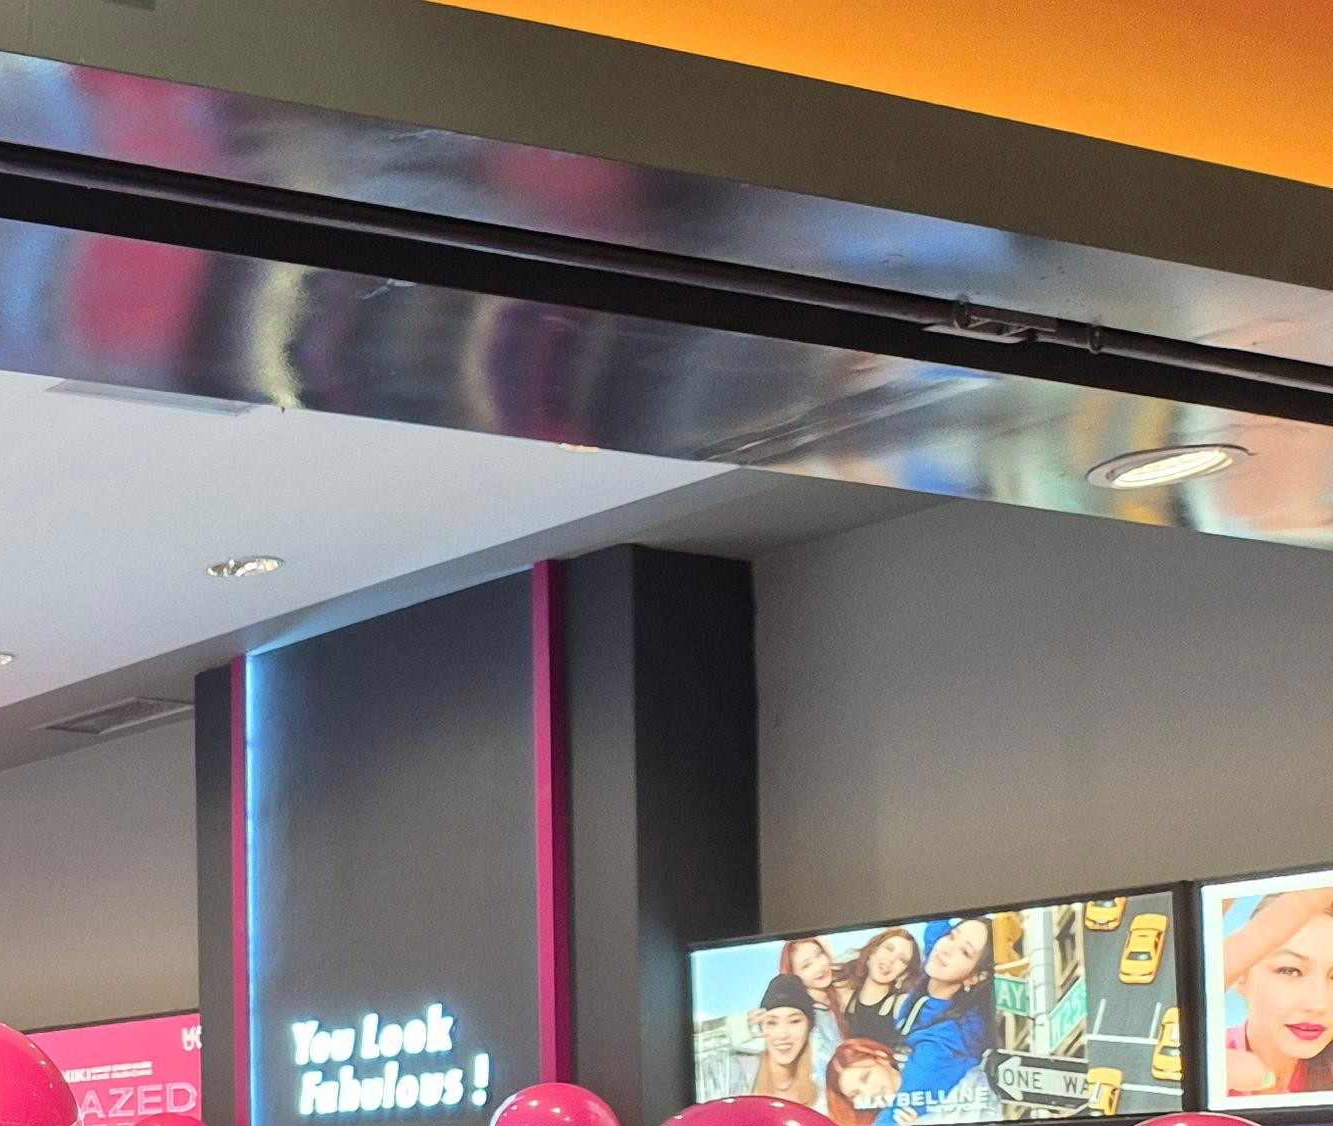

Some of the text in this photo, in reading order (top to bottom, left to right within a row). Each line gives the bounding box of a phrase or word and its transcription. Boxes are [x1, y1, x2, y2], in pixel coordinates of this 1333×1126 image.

[292, 1003, 454, 1065] You Look
[299, 1061, 464, 1115] Fabulous
[855, 1086, 989, 1111] MAYBELLINE
[1003, 1069, 1043, 1091] ONE
[83, 1082, 198, 1119] AZED
